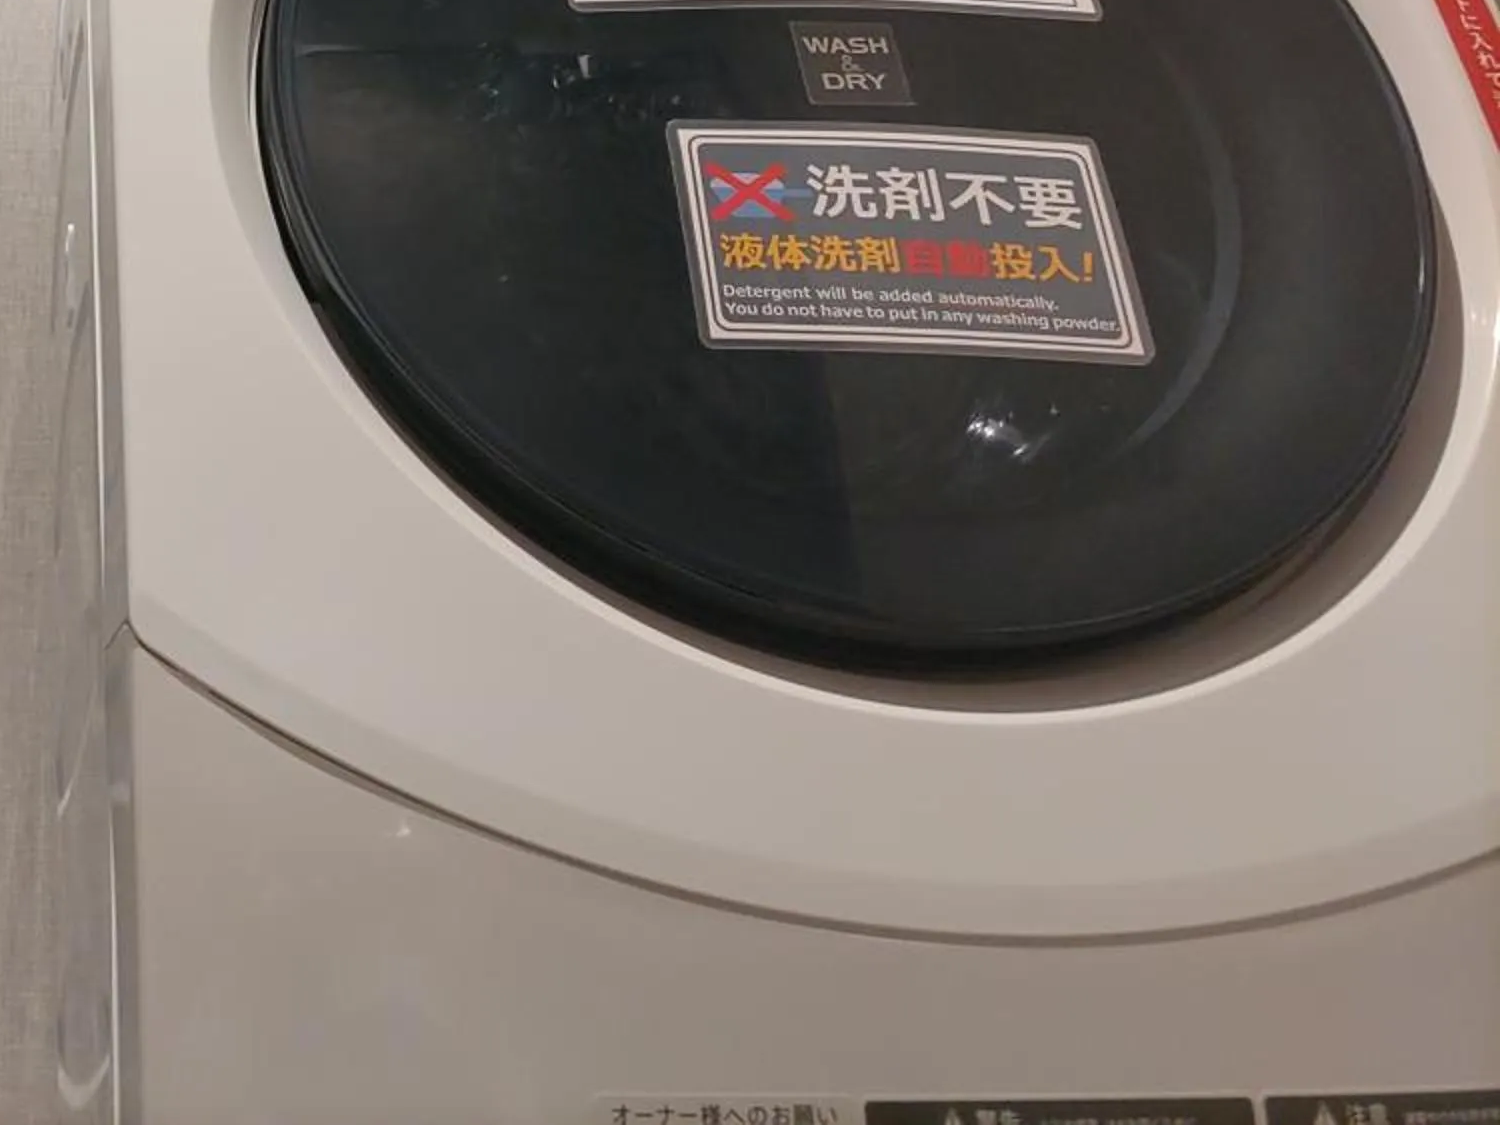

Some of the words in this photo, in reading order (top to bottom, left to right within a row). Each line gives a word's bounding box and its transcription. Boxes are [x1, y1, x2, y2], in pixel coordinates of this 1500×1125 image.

[802, 36, 890, 54] WASH
[841, 54, 865, 72] &
[821, 72, 886, 91] DRY
[806, 163, 1084, 230] 洗剤不要
[723, 284, 811, 302] Detergent
[815, 286, 848, 301] will
[852, 287, 874, 301] be
[878, 288, 934, 306] added
[937, 292, 1061, 311] automatically.
[725, 302, 759, 318] You
[761, 303, 785, 318] do
[787, 303, 818, 319] not
[820, 304, 864, 320] have
[866, 306, 886, 321] to
[888, 307, 919, 325] put
[921, 307, 939, 323] in
[942, 310, 973, 328] any
[976, 310, 1049, 331] washing
[1052, 315, 1122, 334] powder.
[611, 1104, 838, 1125] オーナー様へのお願い
